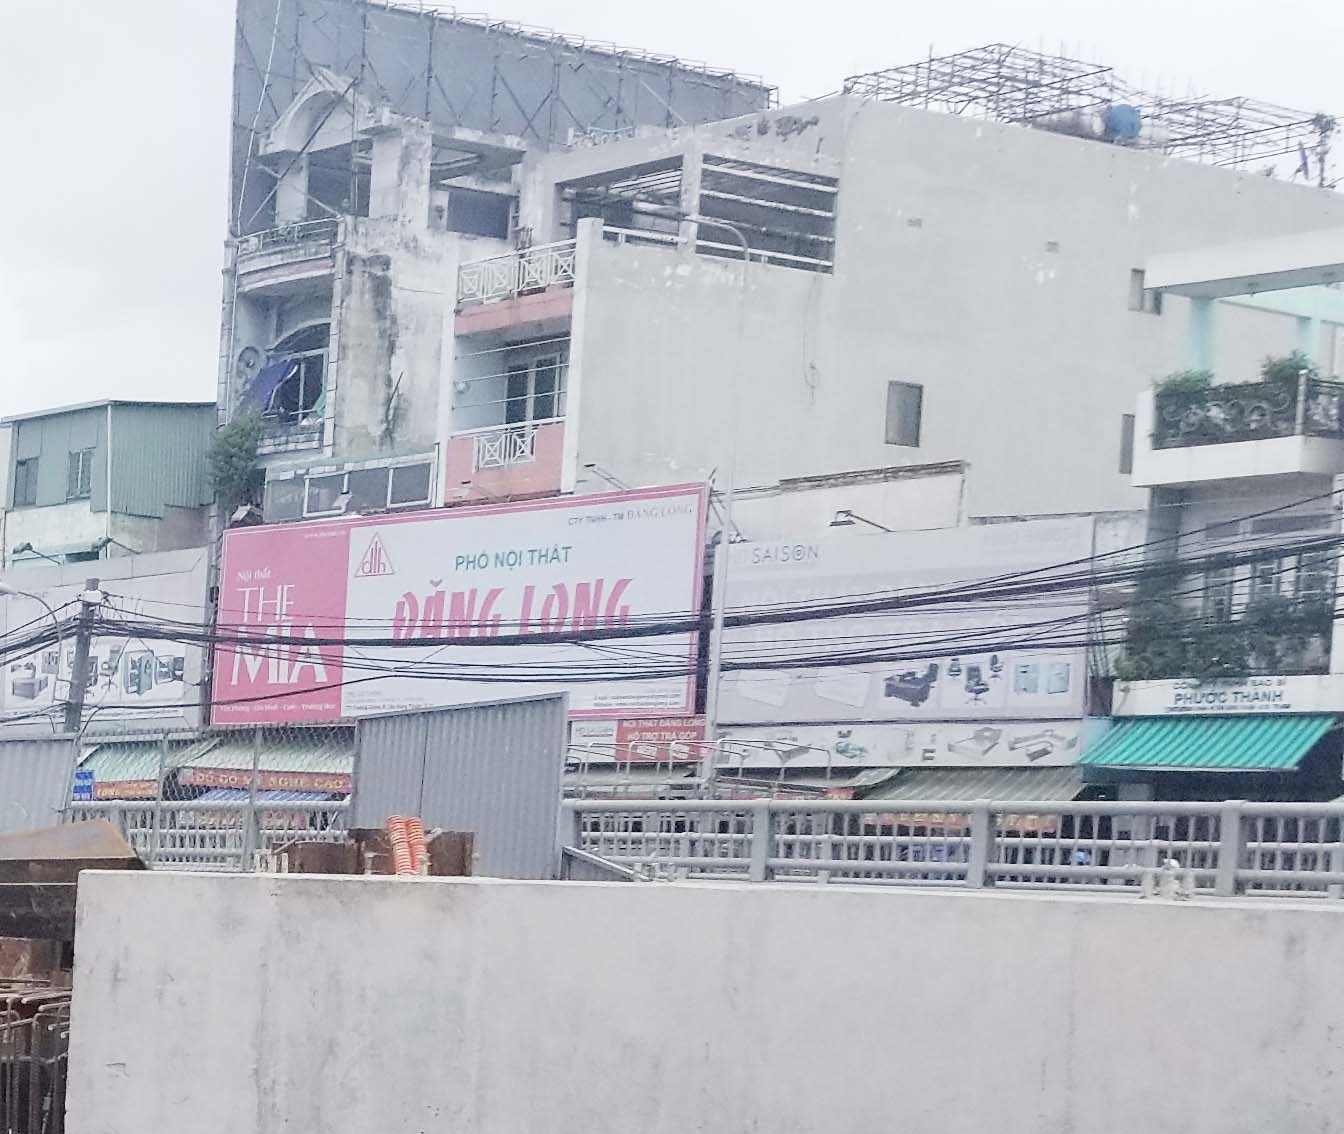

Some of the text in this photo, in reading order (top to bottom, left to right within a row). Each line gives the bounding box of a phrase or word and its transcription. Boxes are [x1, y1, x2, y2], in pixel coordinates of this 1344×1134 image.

[236, 584, 295, 623] THE
[519, 578, 633, 638] LONG
[230, 621, 329, 687] MIA
